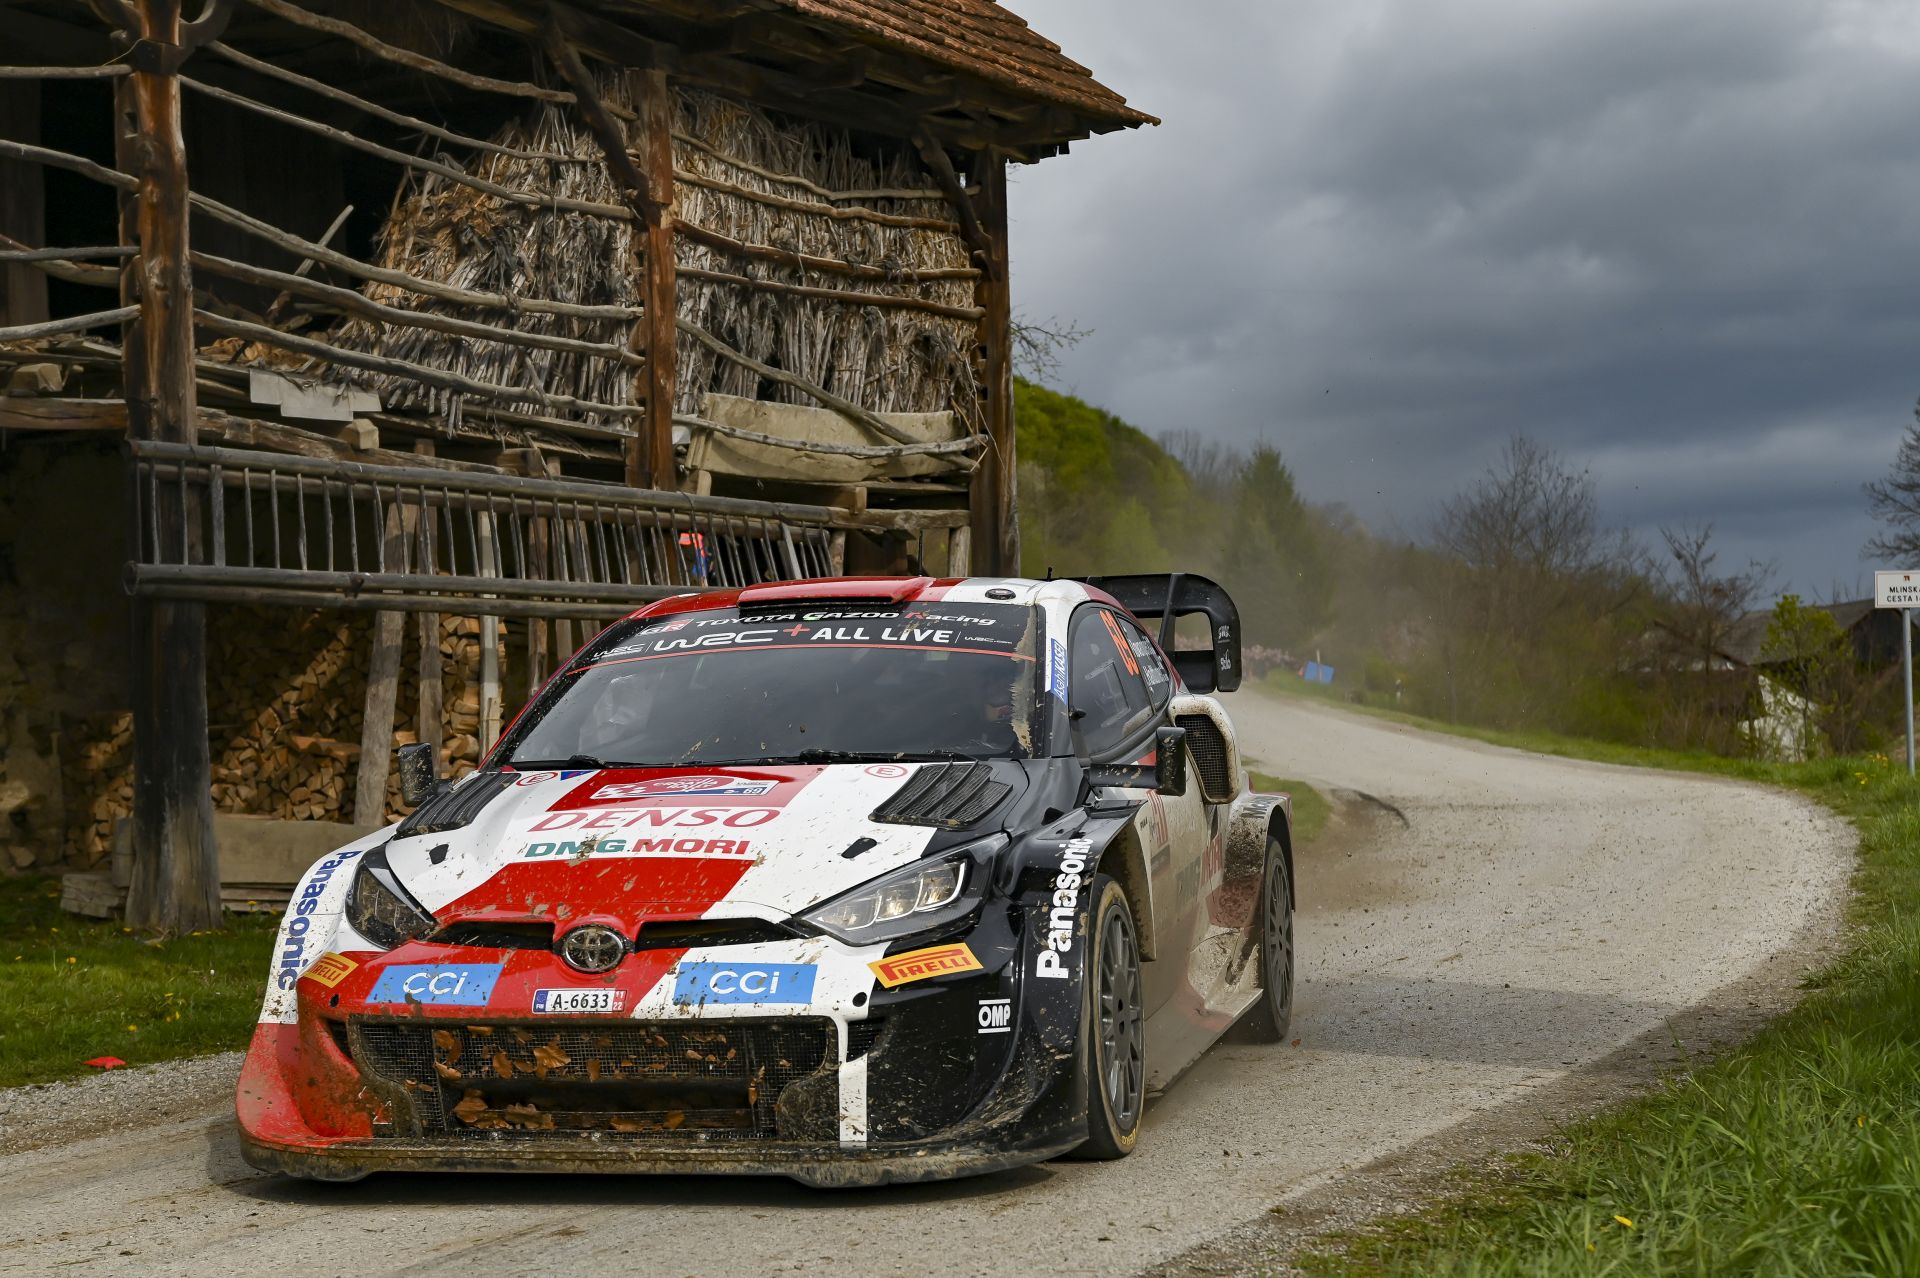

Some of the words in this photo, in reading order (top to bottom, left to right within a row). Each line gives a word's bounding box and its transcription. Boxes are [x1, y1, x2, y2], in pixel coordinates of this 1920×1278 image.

[1886, 595, 1913, 603] CESTA
[696, 613, 797, 629] TOYOTA
[802, 611, 900, 621] GAZOO
[904, 612, 997, 626] Racing
[810, 627, 870, 641] ALL
[881, 627, 953, 644] LIVE
[1099, 608, 1141, 677] 69
[742, 787, 763, 795] 69
[527, 808, 781, 833] DENSO
[524, 839, 627, 858] DMG
[631, 838, 751, 855] MORI
[1036, 837, 1094, 979] Panasonic
[277, 850, 363, 991] Panasonic
[878, 948, 972, 982] PIRELLI
[709, 970, 780, 995] CCi
[551, 993, 610, 1010] A-6633
[612, 1001, 622, 1010] 22
[978, 1004, 1011, 1028] OMP
